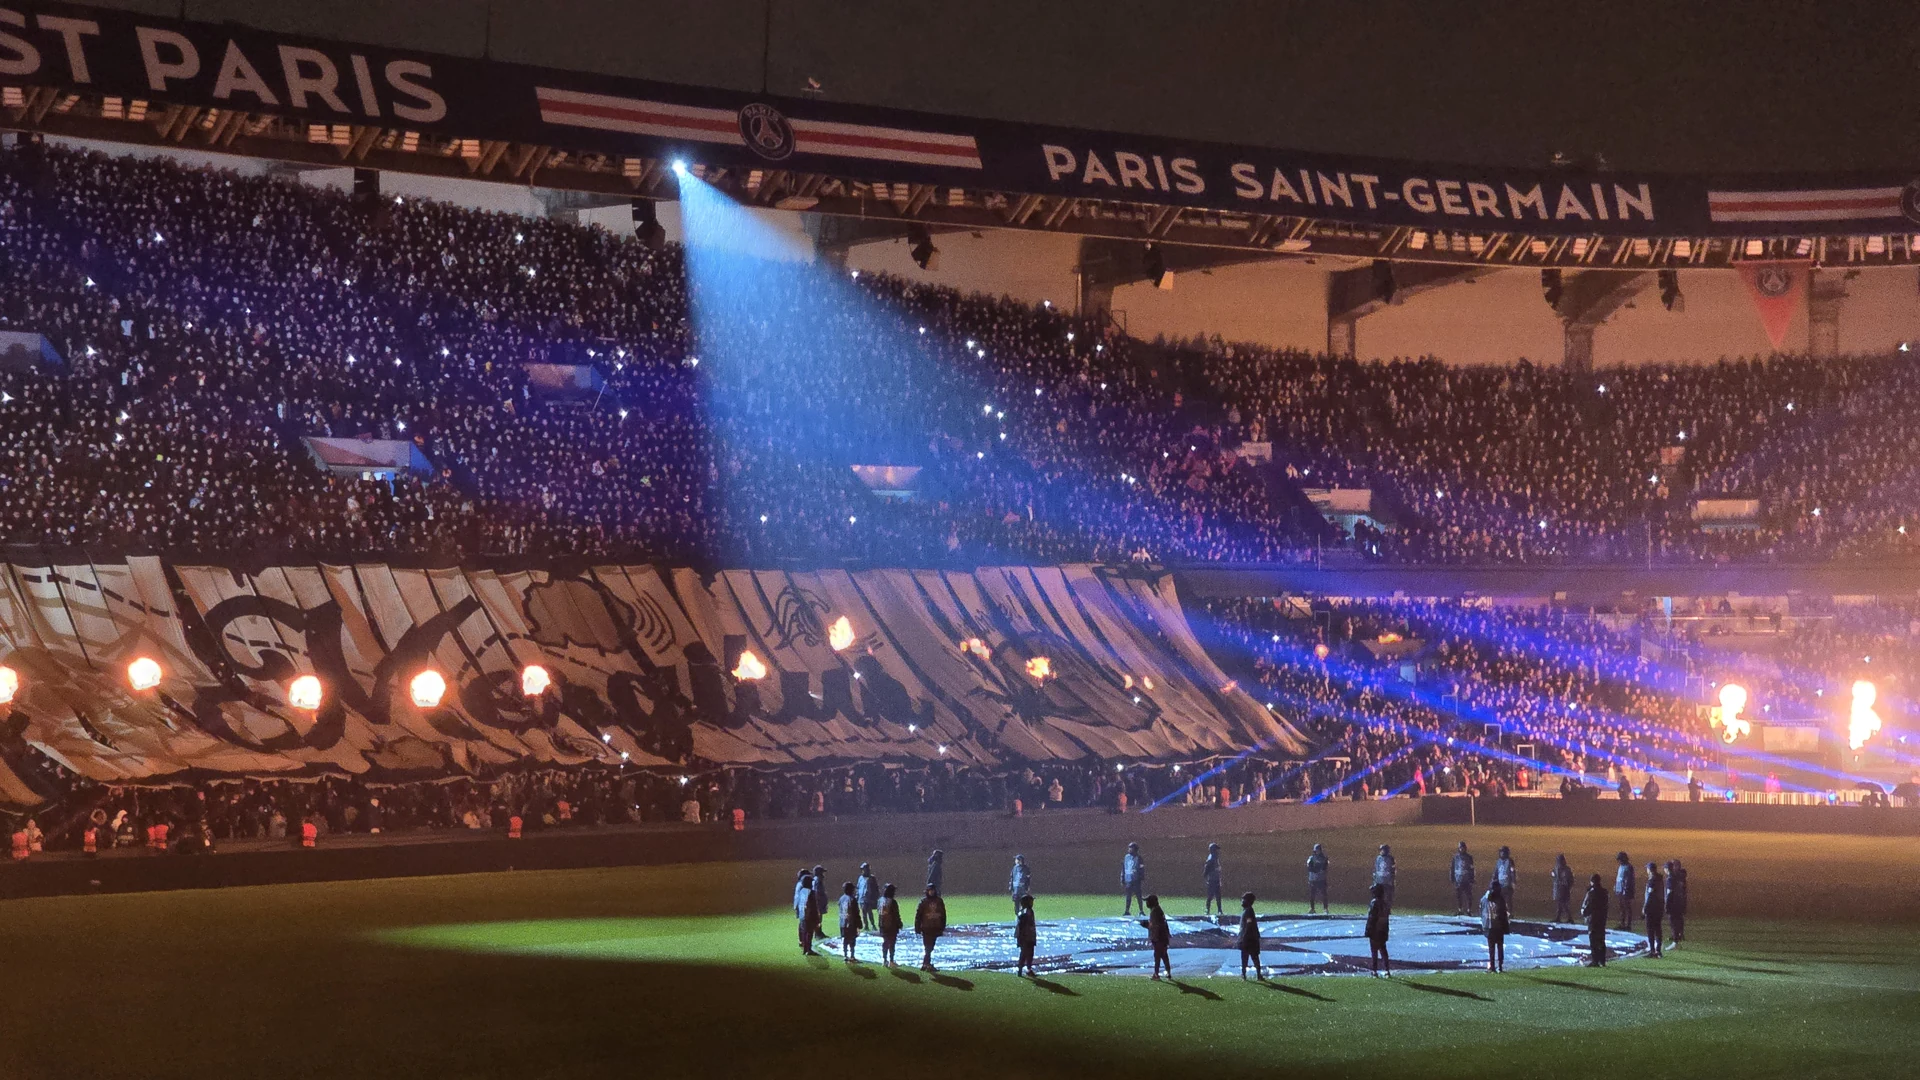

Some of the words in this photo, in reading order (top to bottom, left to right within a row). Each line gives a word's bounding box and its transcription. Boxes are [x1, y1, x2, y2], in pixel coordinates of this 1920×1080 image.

[135, 26, 447, 123] PARIS
[1042, 144, 1206, 195] PARIS
[1232, 163, 1655, 221] SAINT-GERMAIN
